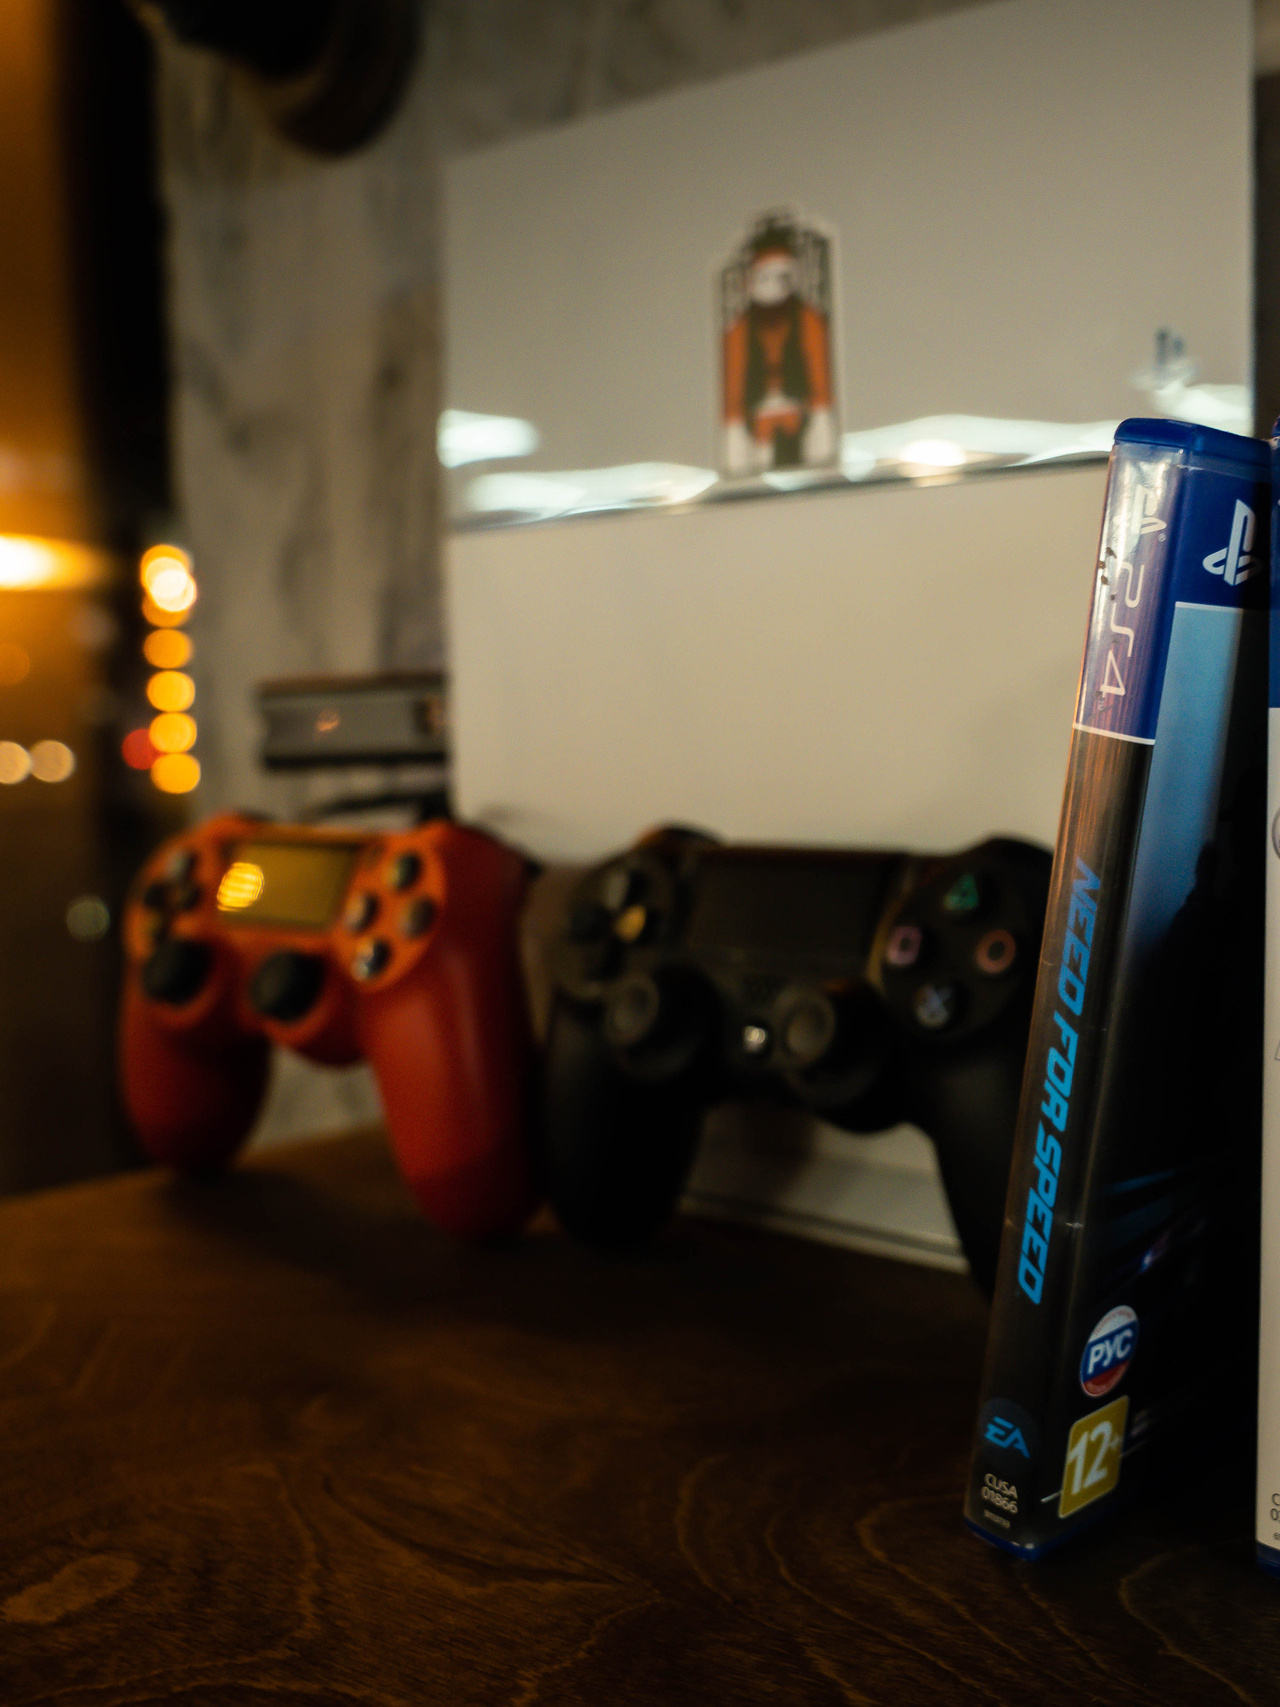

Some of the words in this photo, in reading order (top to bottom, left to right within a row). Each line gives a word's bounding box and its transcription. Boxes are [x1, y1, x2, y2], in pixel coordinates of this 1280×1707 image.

[1058, 856, 1101, 1016] NEED
[1040, 1010, 1079, 1132] FOR
[1017, 1120, 1063, 1305] SPEED
[1087, 1328, 1134, 1375] РУС
[984, 1415, 1030, 1458] EA
[984, 1473, 1018, 1499] CUSA
